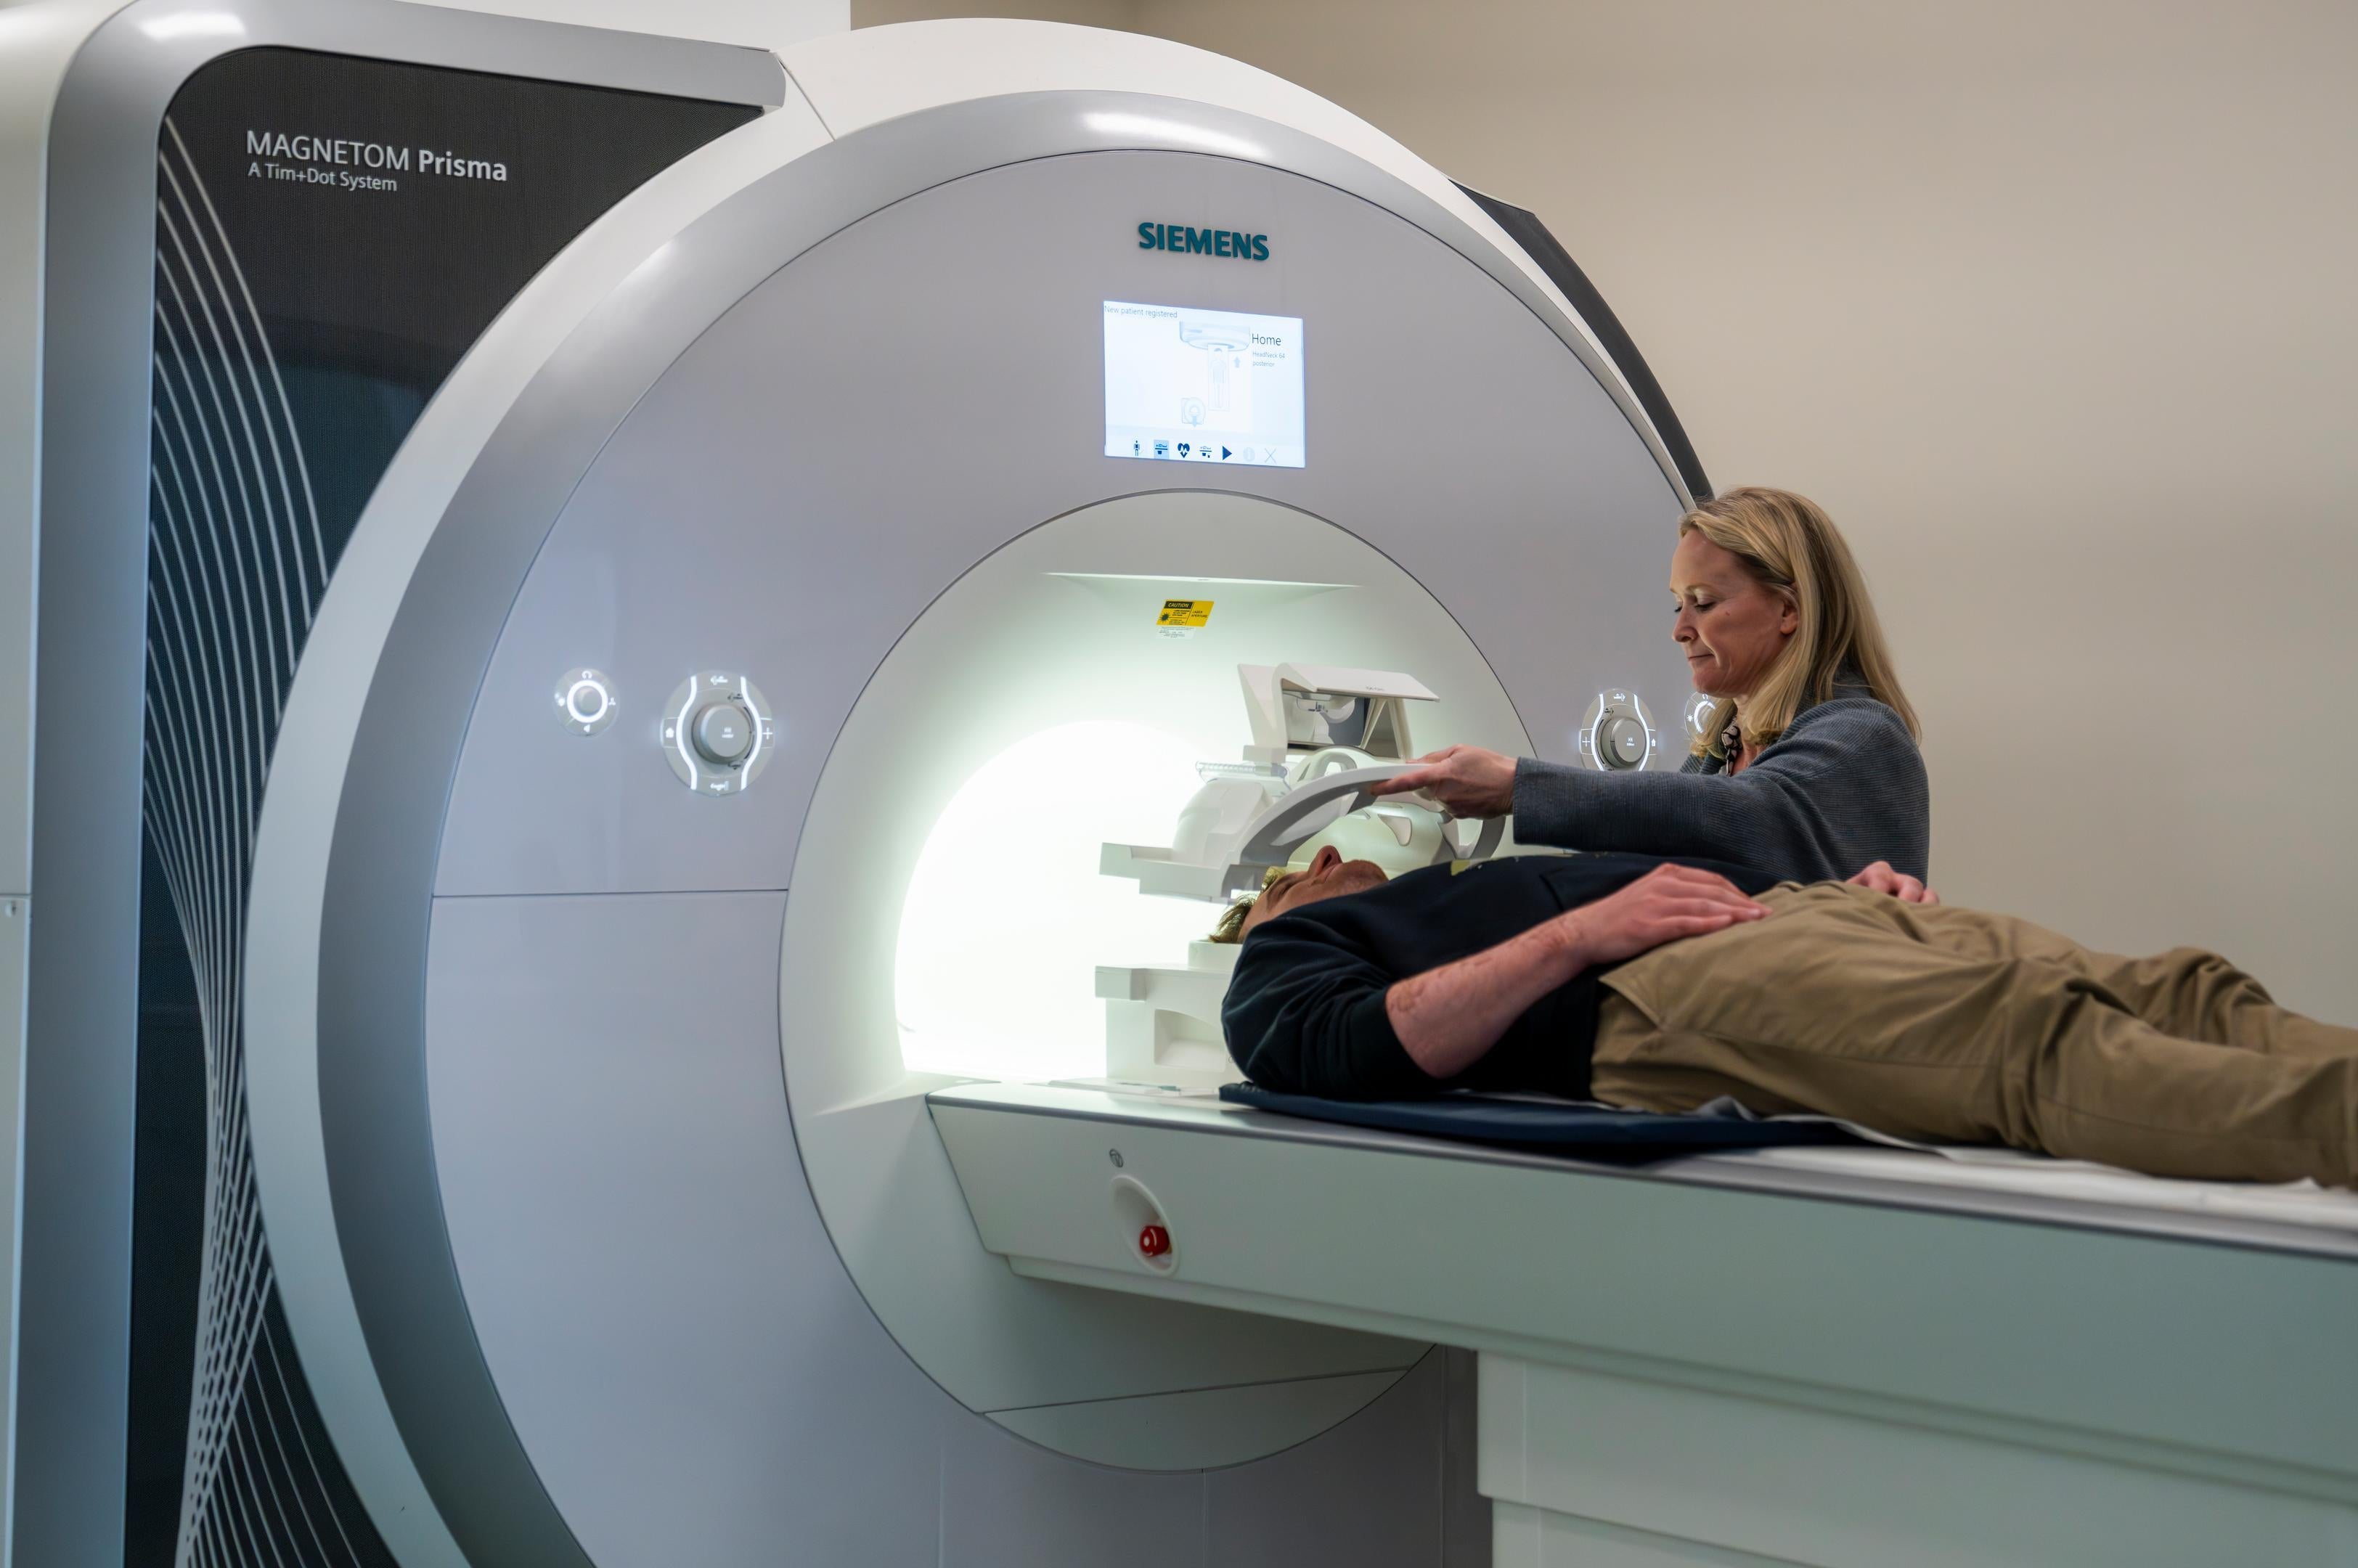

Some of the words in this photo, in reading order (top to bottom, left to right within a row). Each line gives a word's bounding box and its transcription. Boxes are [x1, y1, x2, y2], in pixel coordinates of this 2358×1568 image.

[247, 130, 409, 171] MAGNETOM
[418, 150, 507, 181] Prisma
[248, 162, 261, 178] A
[264, 163, 335, 185] Tim+Dot
[339, 171, 397, 191] System
[1138, 221, 1270, 261] SIEMENS
[1121, 307, 1143, 316] patient
[1146, 309, 1178, 319] registered
[1252, 333, 1281, 346] Home
